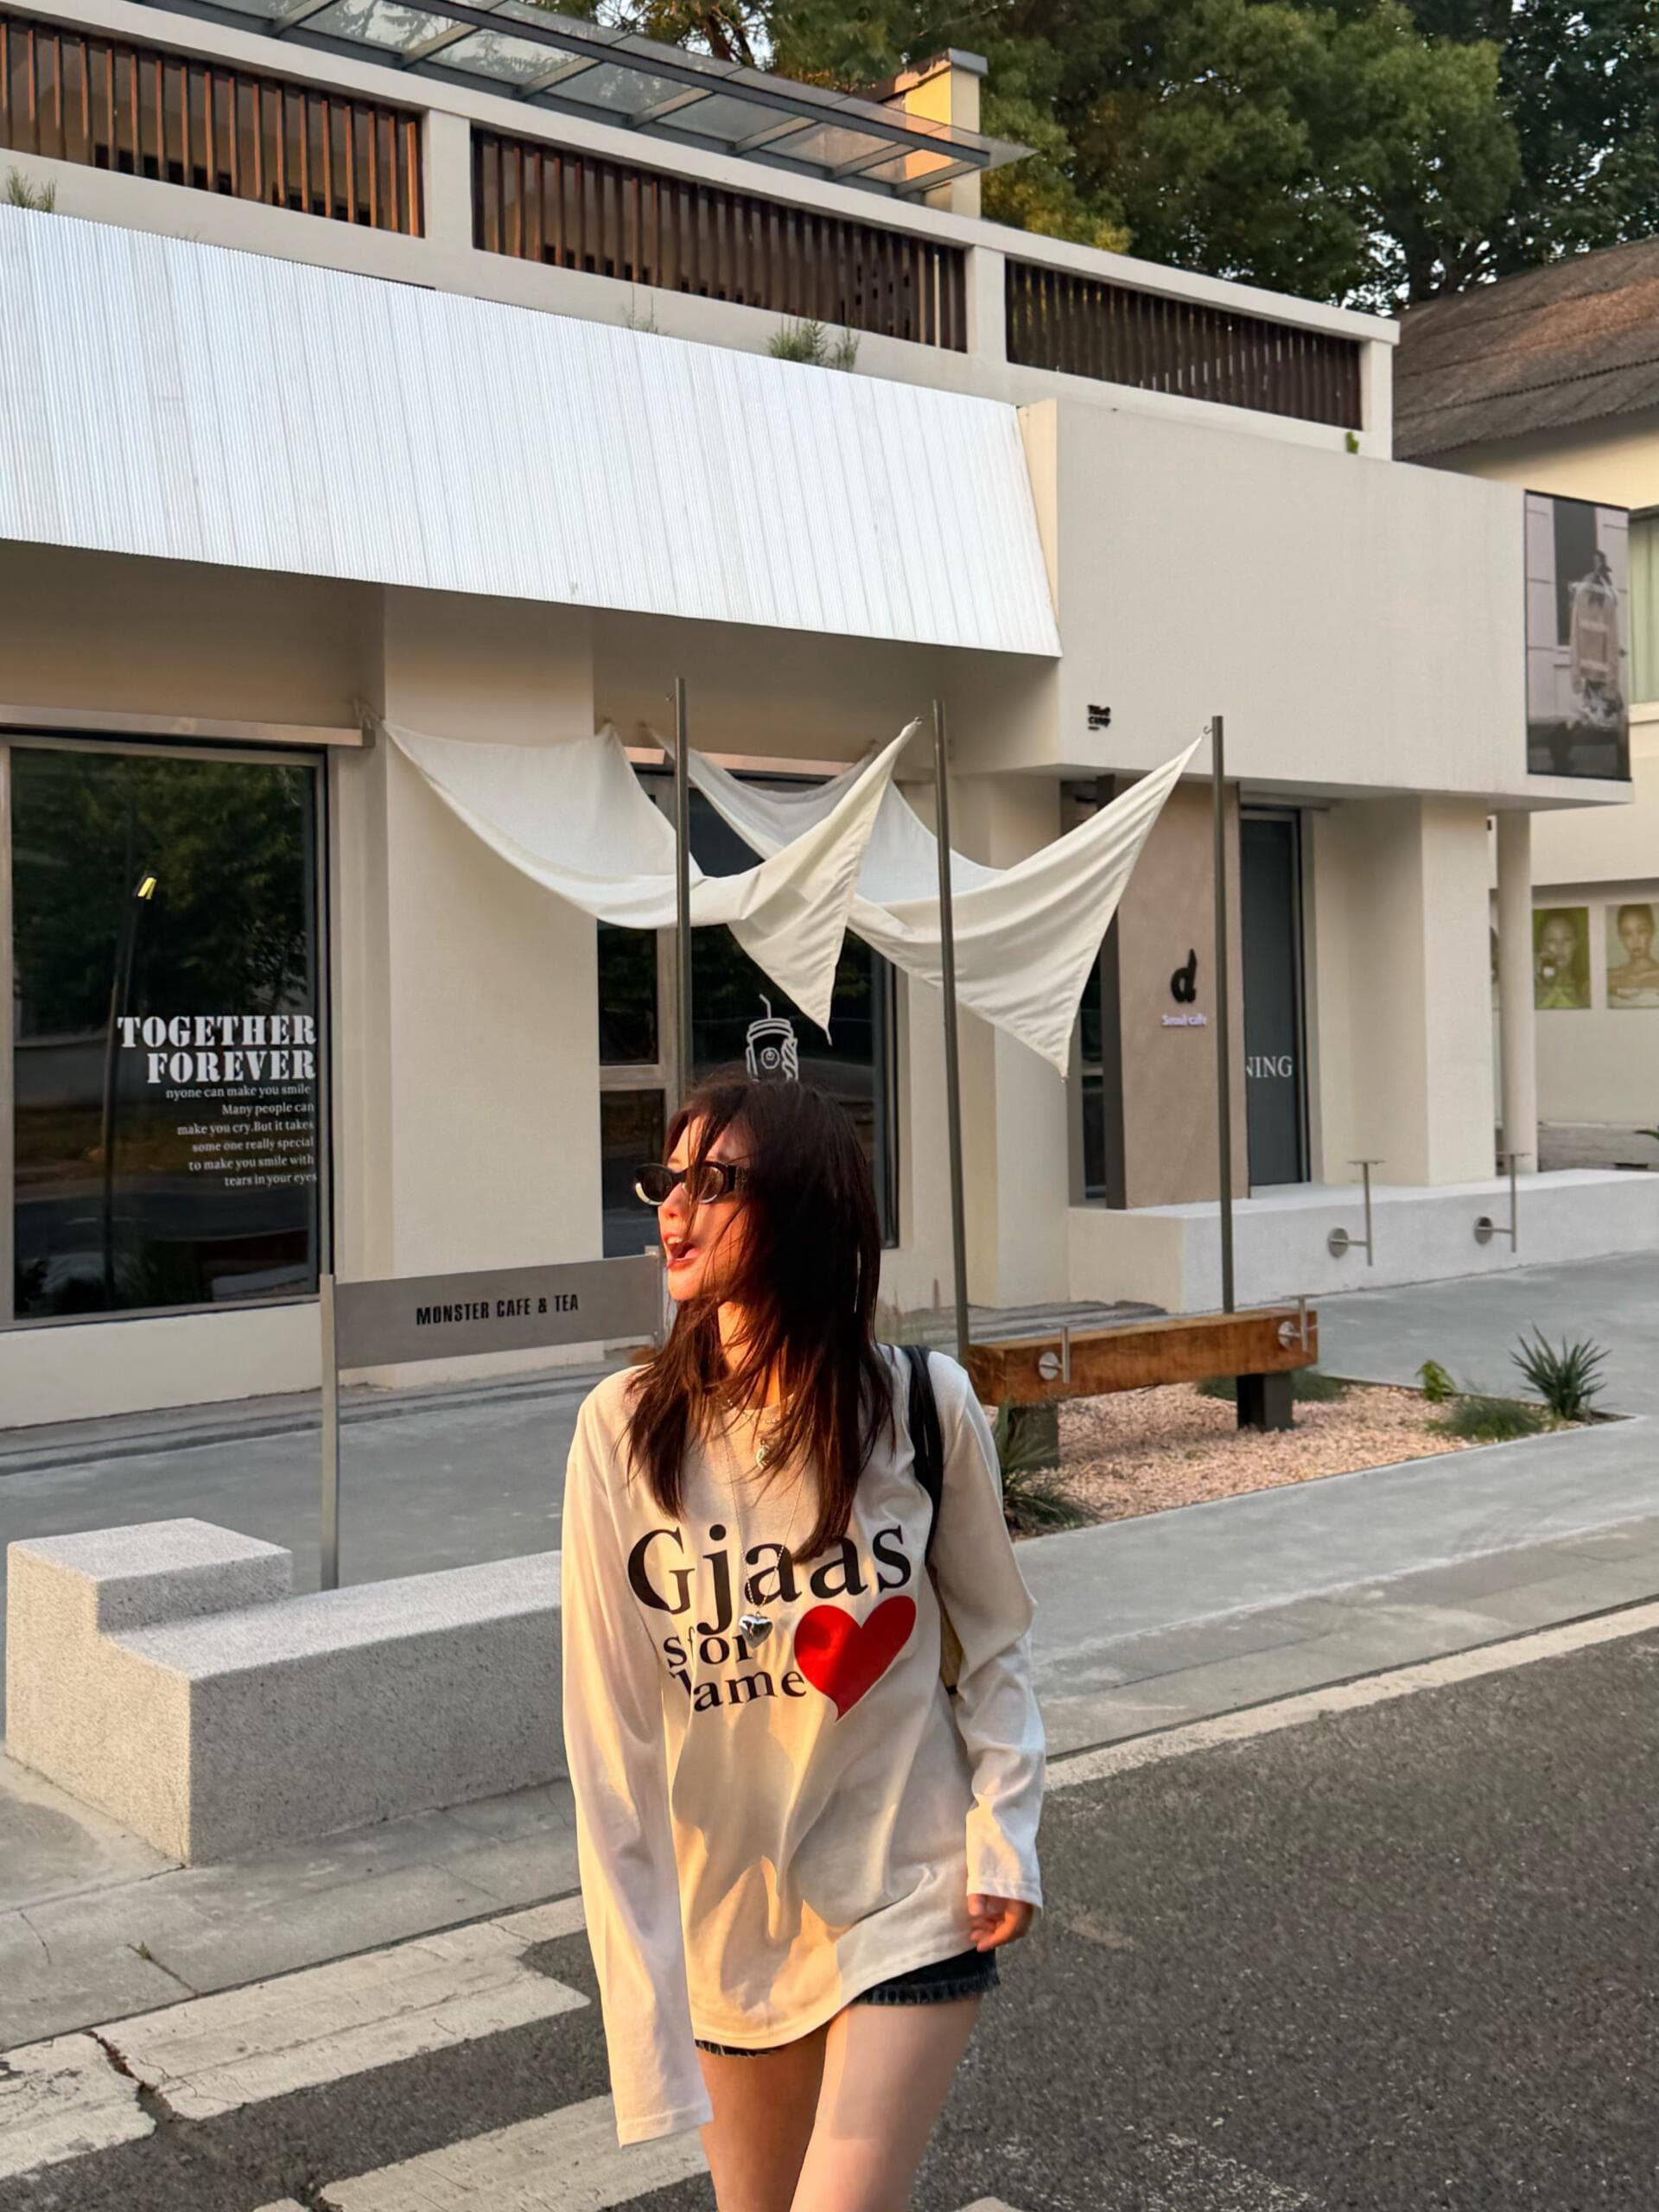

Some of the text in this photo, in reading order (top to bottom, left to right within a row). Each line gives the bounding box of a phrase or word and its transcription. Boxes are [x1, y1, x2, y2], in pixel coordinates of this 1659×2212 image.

[118, 1015, 316, 1047] TOGETHER
[147, 1050, 315, 1084] FOREVER
[166, 1084, 311, 1102] nyone can make you smile
[222, 1102, 315, 1117] Many people can
[177, 1123, 207, 1135] make
[210, 1124, 231, 1137] you
[275, 1120, 283, 1131] it
[286, 1119, 315, 1131] takes
[192, 1136, 315, 1153] some one really special
[188, 1154, 315, 1172] to make you smile with
[225, 1173, 318, 1187] tears in your eyes
[416, 1294, 578, 1325] MONSTER CAFE & TEA
[627, 1523, 912, 1636] Gjaas
